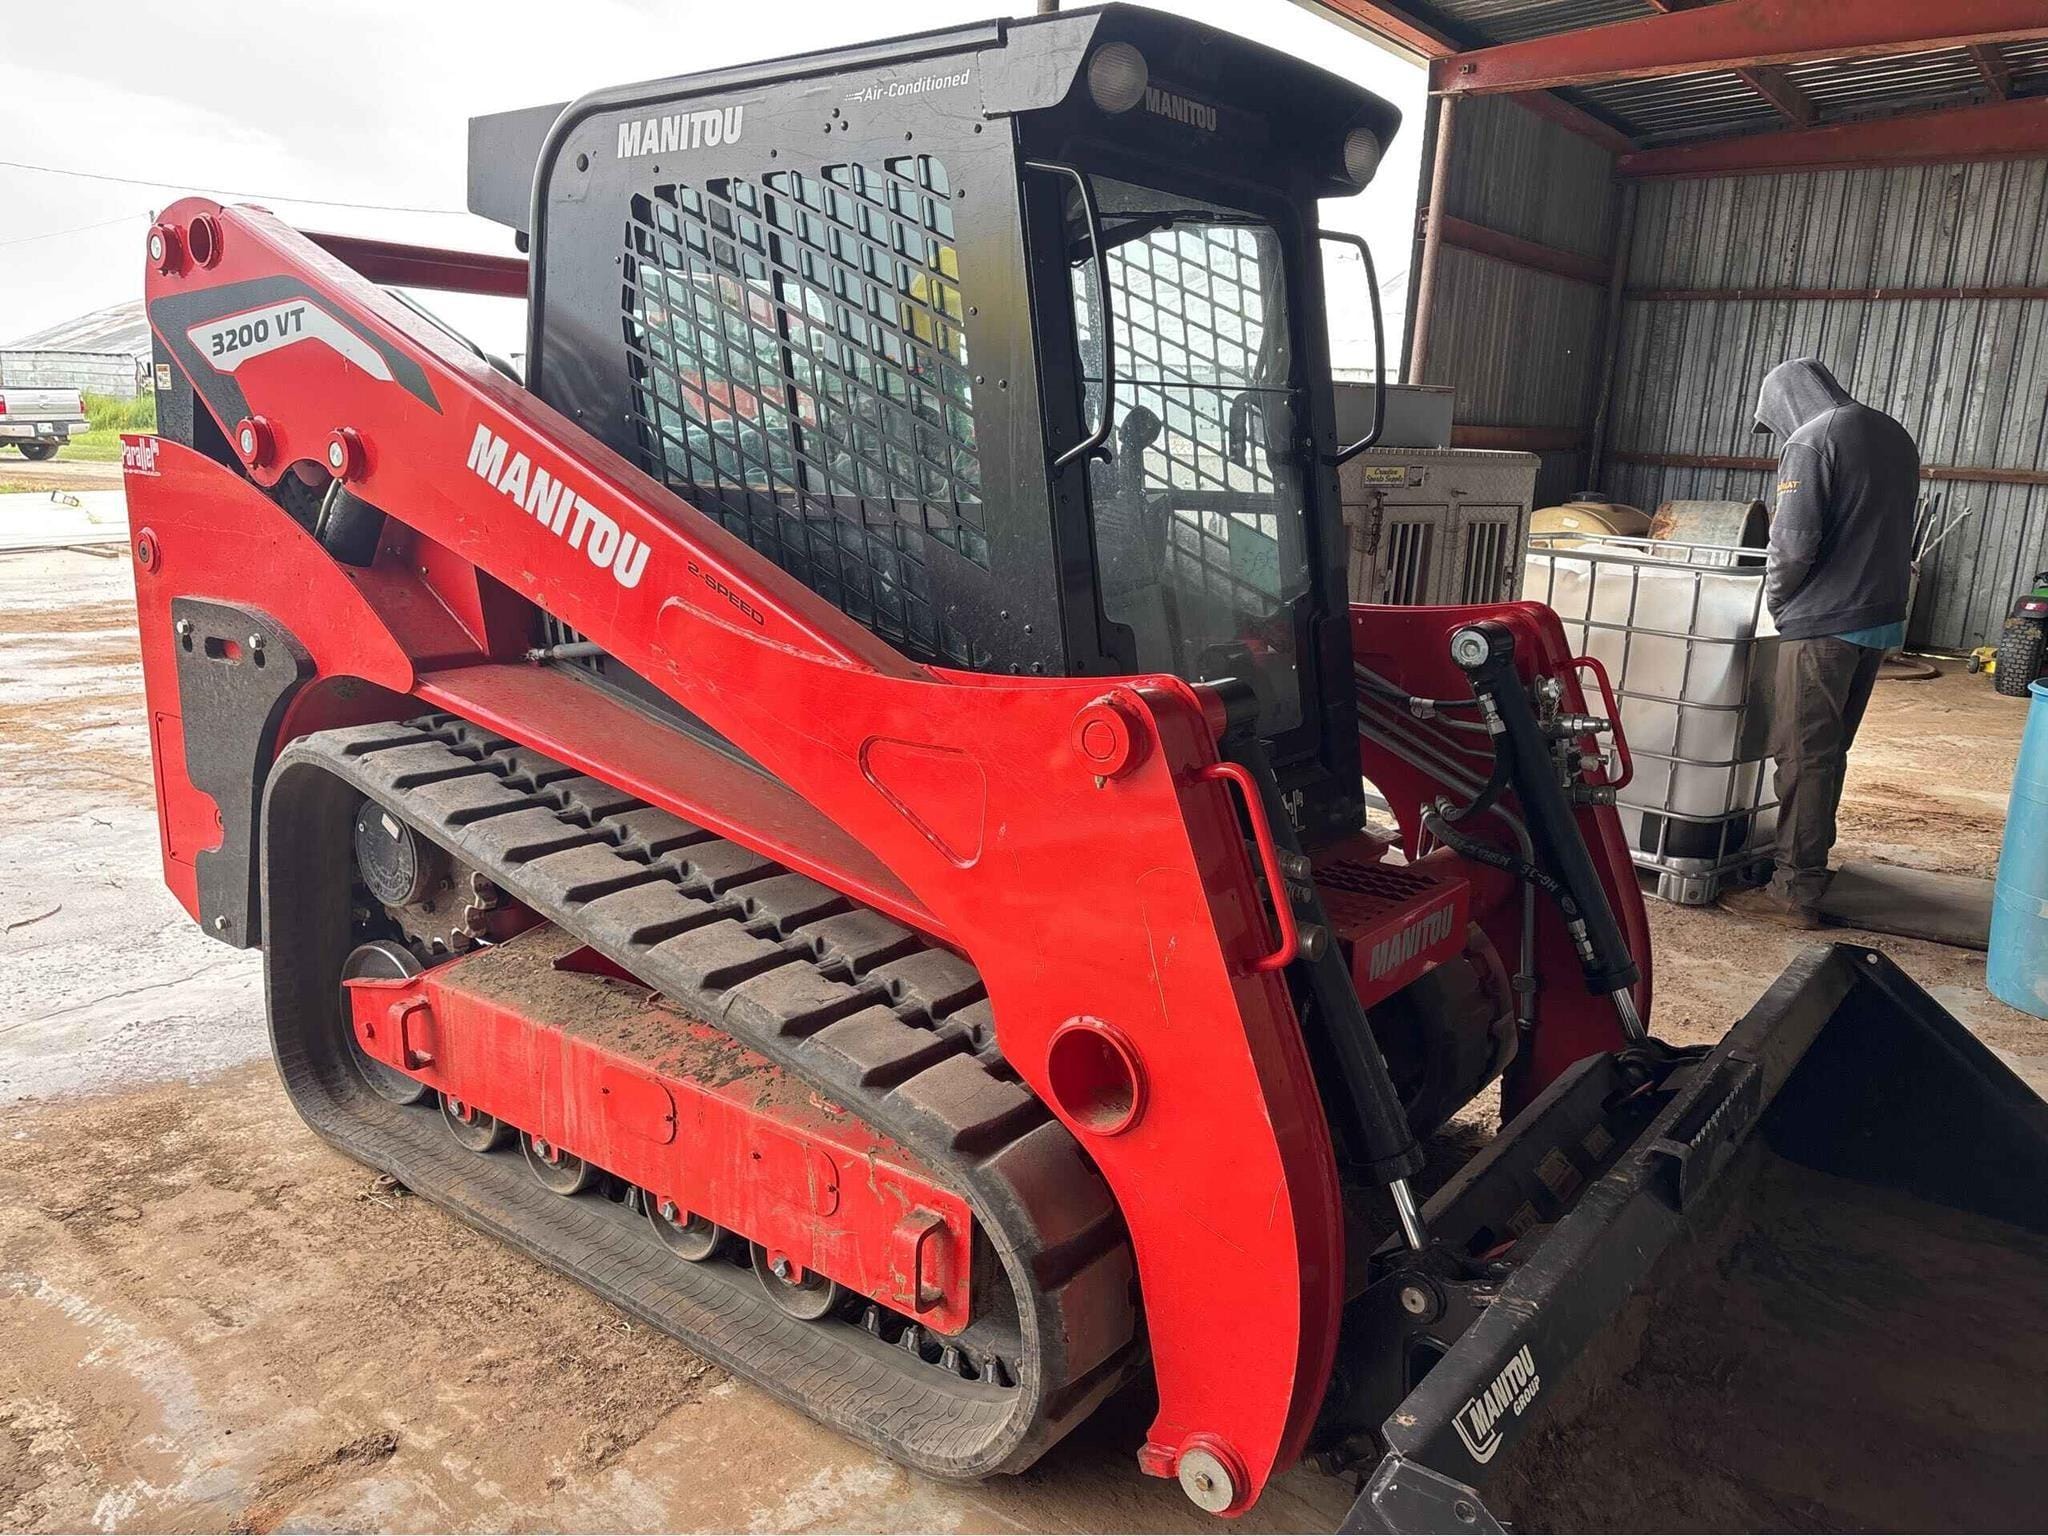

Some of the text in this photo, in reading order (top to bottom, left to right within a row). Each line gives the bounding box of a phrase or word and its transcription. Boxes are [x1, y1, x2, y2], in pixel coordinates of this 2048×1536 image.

[863, 68, 970, 101] Air-Conditioned
[1145, 86, 1217, 132] MANITOU
[617, 105, 743, 159] MANITOU
[211, 306, 305, 356] 3200 VT
[466, 422, 652, 589] MANITOU
[687, 560, 765, 626] 2-SPEED
[1369, 903, 1454, 982] MANITOU
[1469, 1344, 1535, 1441] MANITOU
[1513, 1374, 1541, 1416] GROUP
